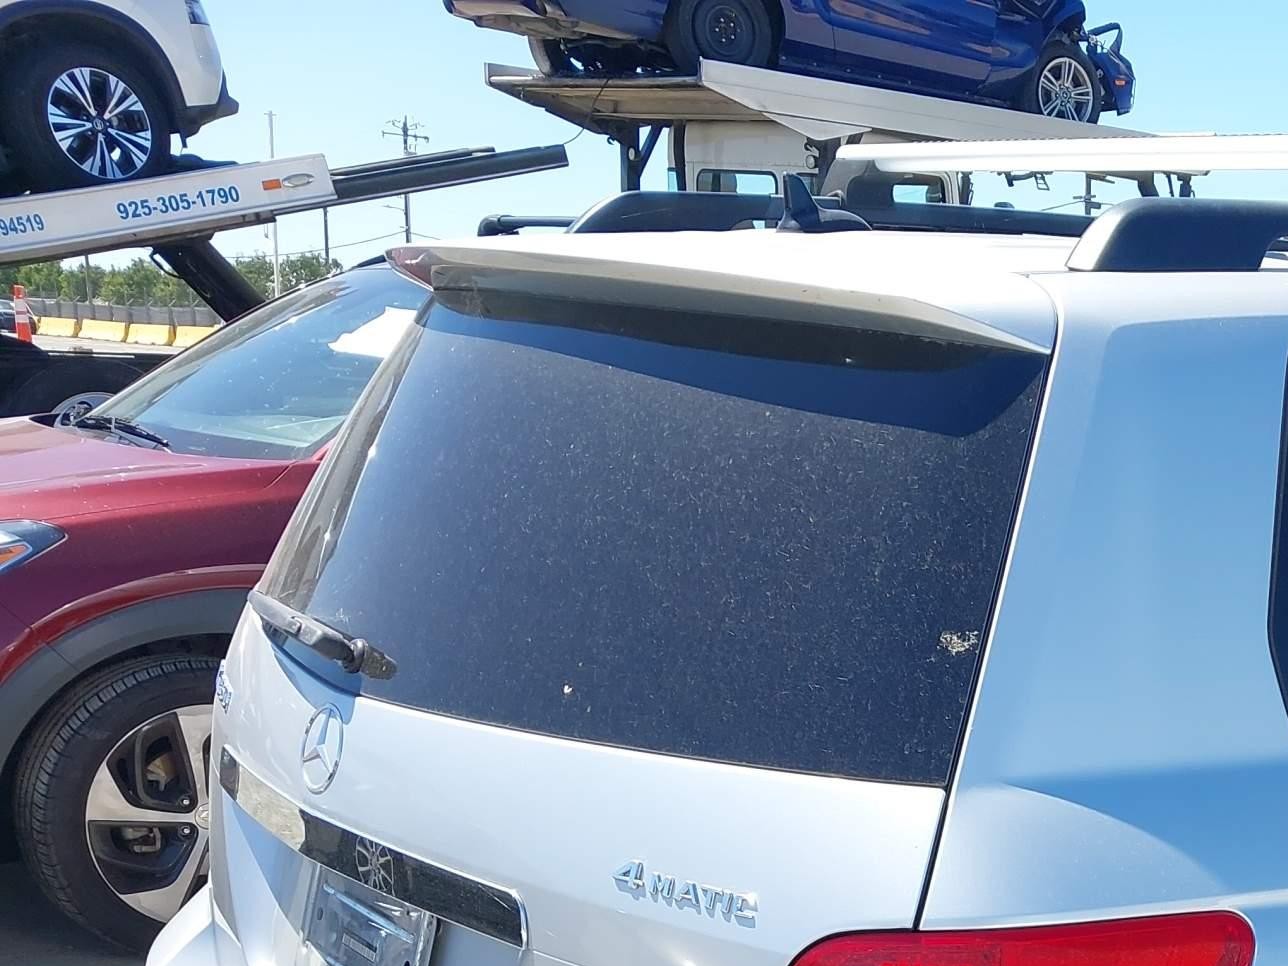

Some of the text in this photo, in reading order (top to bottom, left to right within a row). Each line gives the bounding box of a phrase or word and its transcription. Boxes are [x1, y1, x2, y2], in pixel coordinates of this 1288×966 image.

[0, 185, 240, 236] 94519 925-305-1790
[612, 859, 758, 920] 4MATIC
